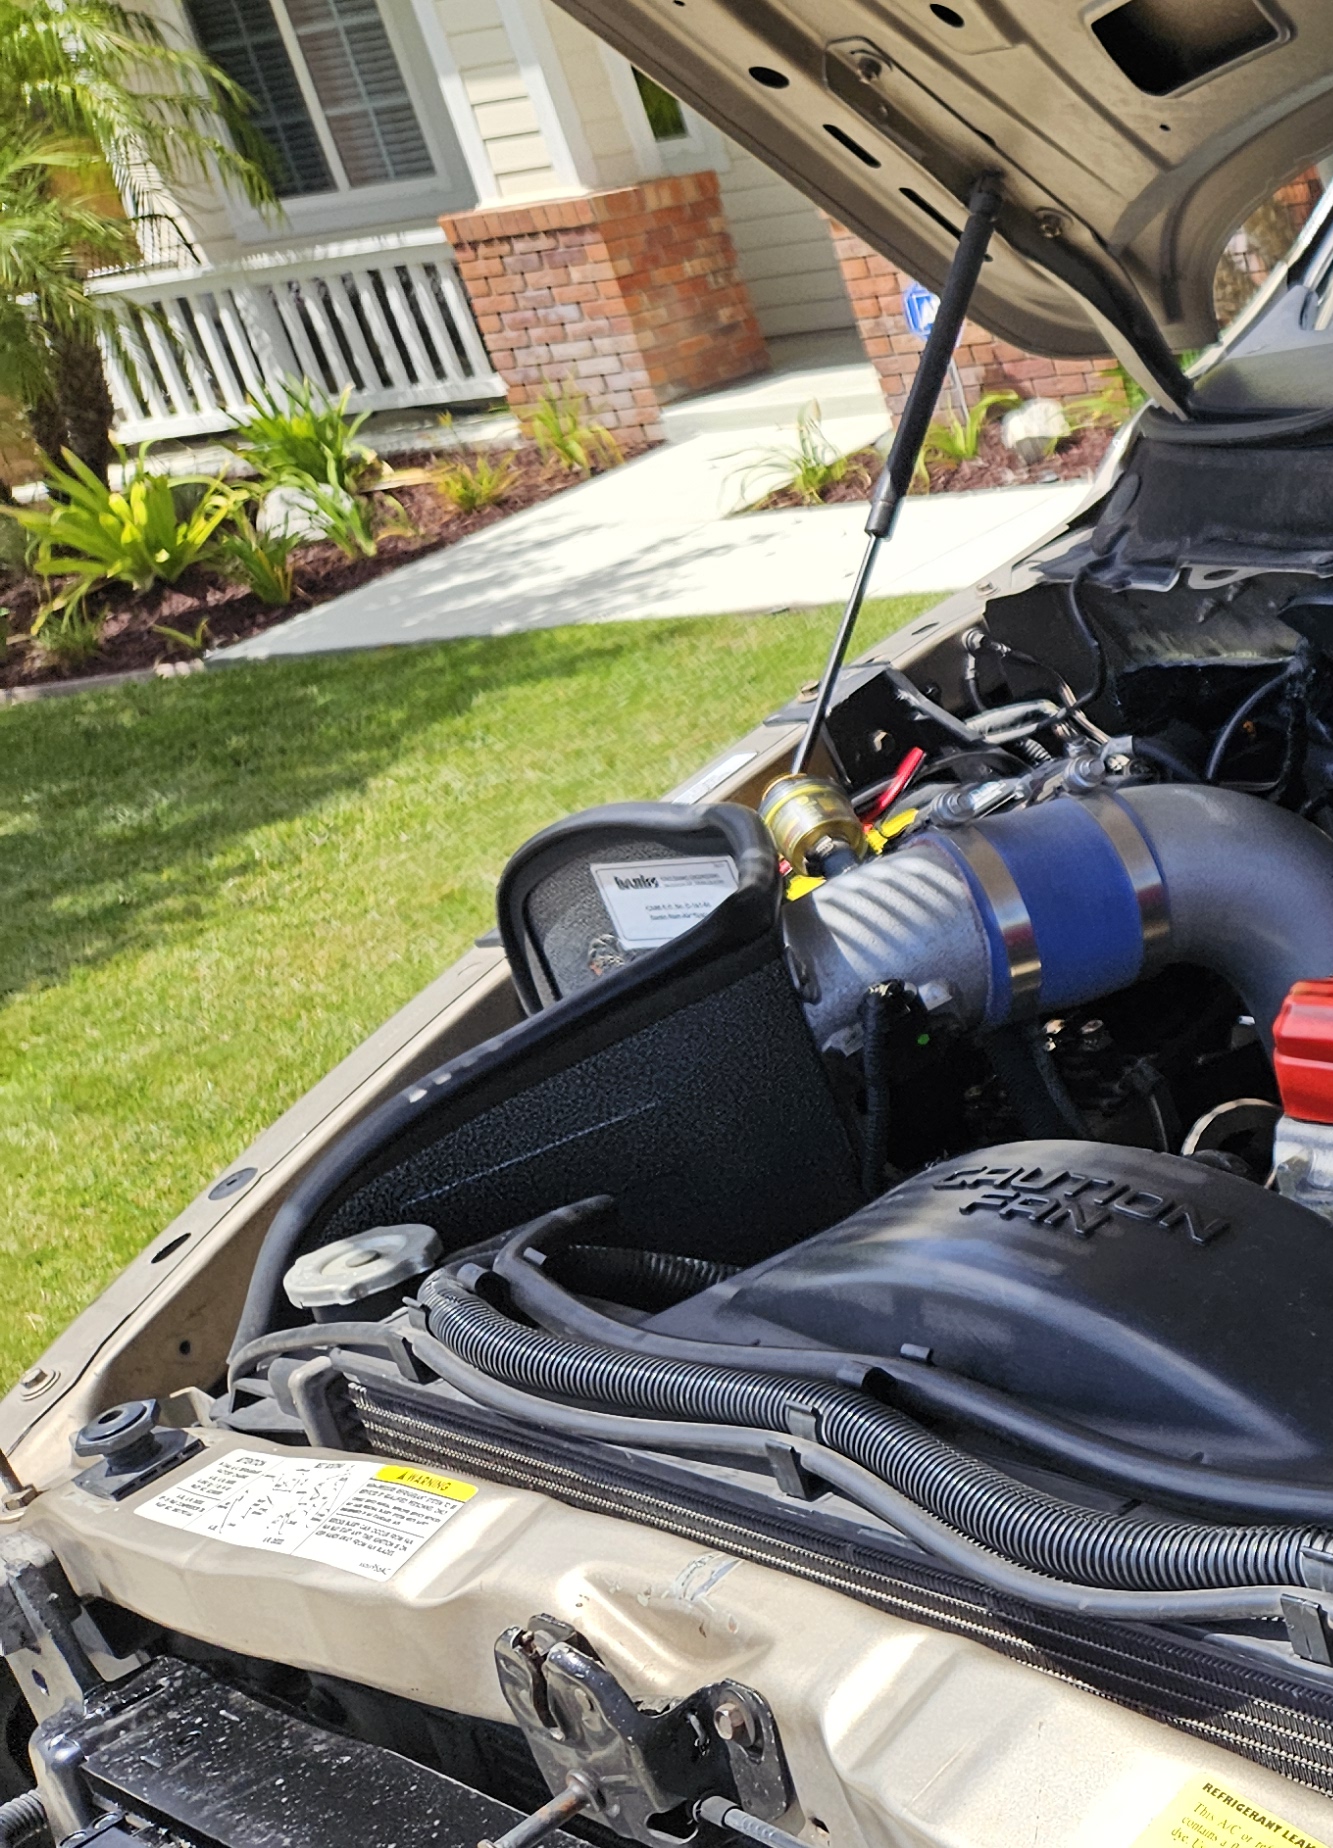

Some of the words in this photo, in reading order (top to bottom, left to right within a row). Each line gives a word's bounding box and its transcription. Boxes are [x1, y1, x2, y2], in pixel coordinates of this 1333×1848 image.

[614, 874, 659, 891] banks
[933, 1166, 1230, 1246] CAUTION
[958, 1190, 1114, 1239] FAN
[407, 1472, 452, 1491] WARNING
[1193, 1802, 1215, 1821] This
[1218, 1819, 1241, 1835] A/C
[1241, 1833, 1253, 1843] or
[1202, 1782, 1283, 1833] REFRIGERANT
[1182, 1816, 1218, 1842] contains
